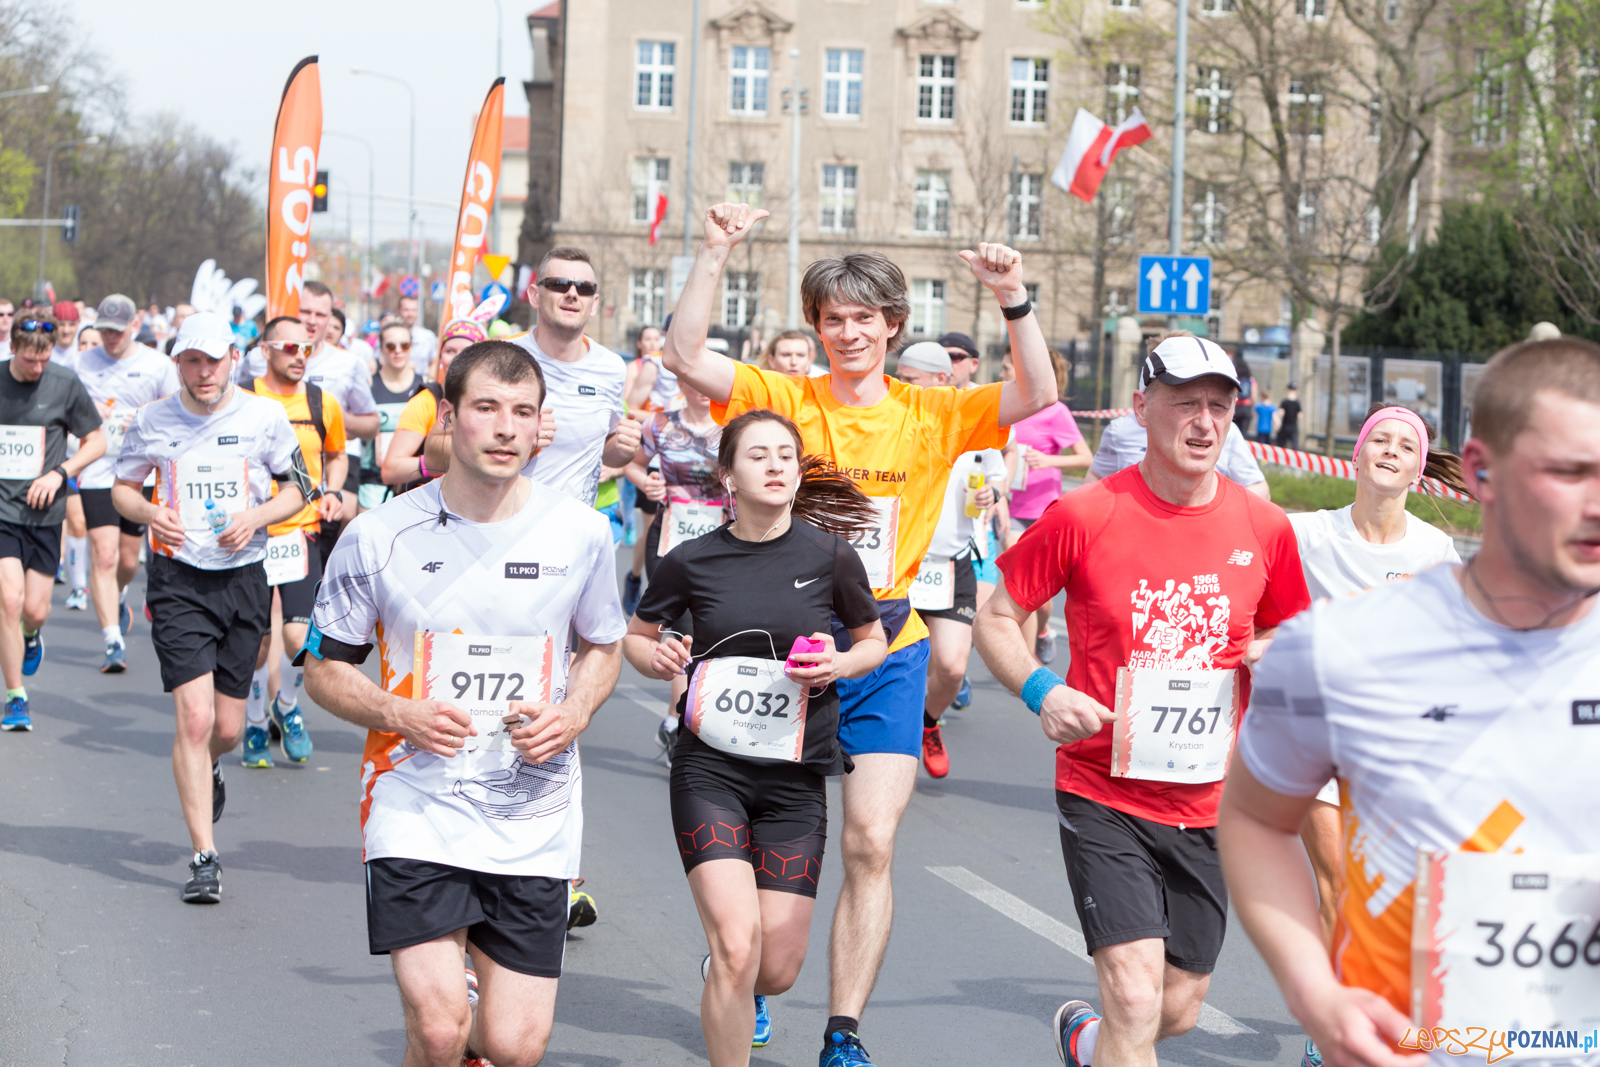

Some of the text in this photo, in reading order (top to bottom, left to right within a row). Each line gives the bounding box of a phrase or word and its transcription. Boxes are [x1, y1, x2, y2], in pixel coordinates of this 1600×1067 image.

[875, 470, 907, 483] TEAM
[186, 481, 238, 499] 11153
[1192, 574, 1219, 584] 1966
[1194, 583, 1220, 594] 2016
[451, 671, 524, 701] 9172
[715, 688, 790, 718] 6032
[470, 708, 504, 716] tomasz
[733, 720, 767, 730] Patrycja
[1151, 706, 1221, 735] 7767
[1169, 741, 1204, 750] Krystian
[1474, 921, 1600, 968] 3666
